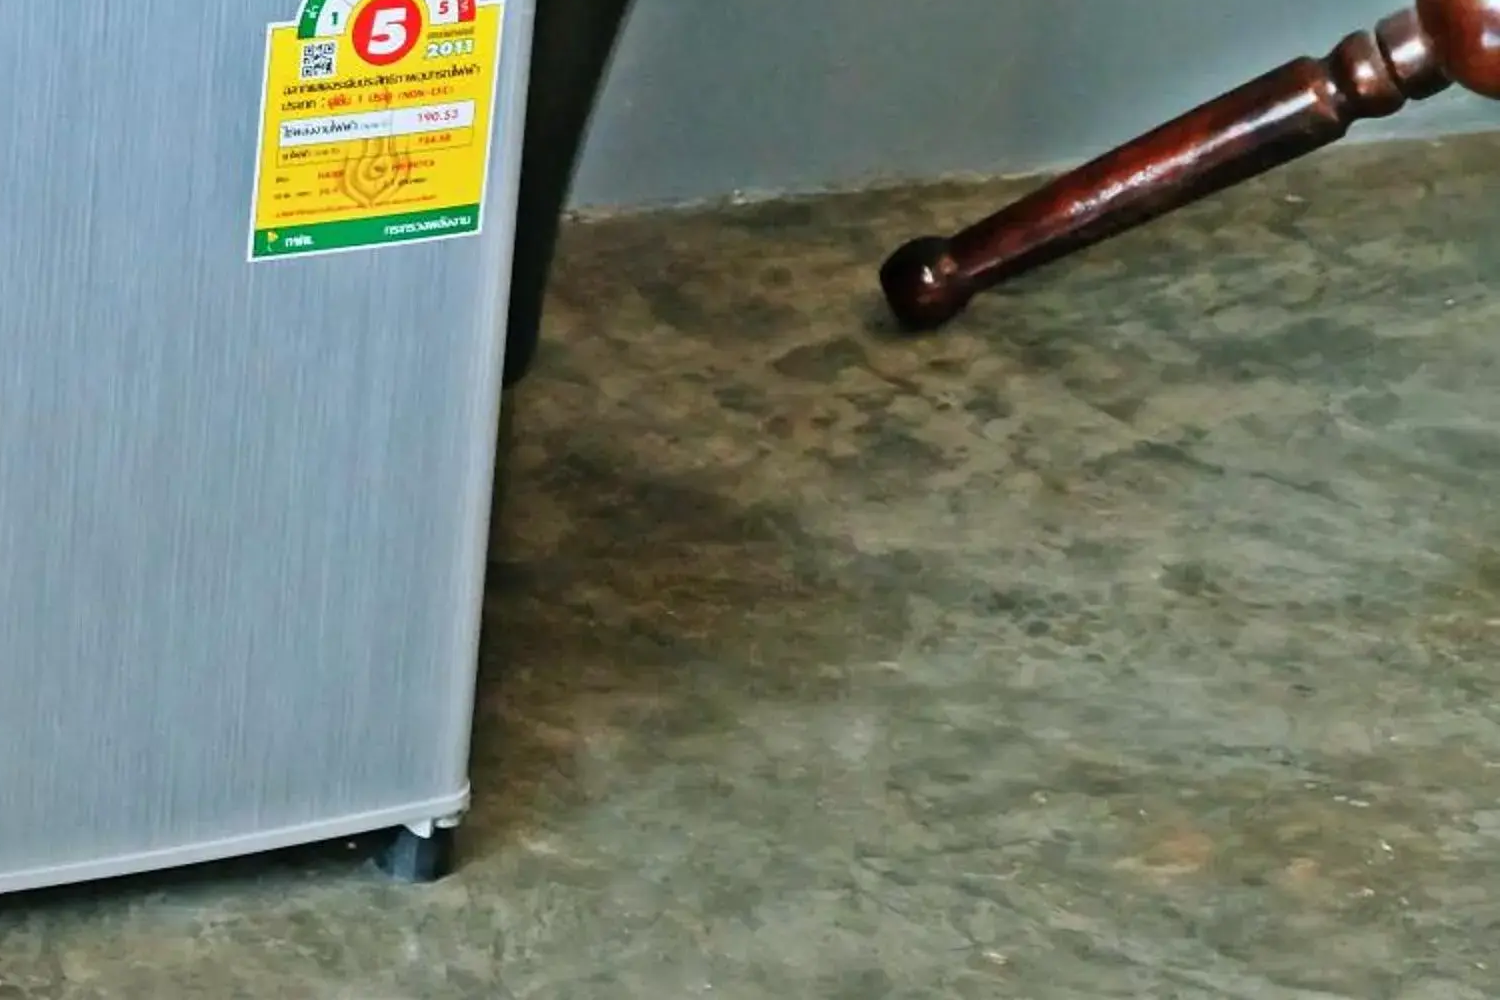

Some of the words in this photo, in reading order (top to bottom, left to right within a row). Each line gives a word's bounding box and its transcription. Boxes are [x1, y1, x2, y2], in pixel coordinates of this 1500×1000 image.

[438, 0, 450, 15] 5
[331, 11, 339, 25] 1
[367, 7, 408, 56] 5
[426, 37, 475, 59] 2011
